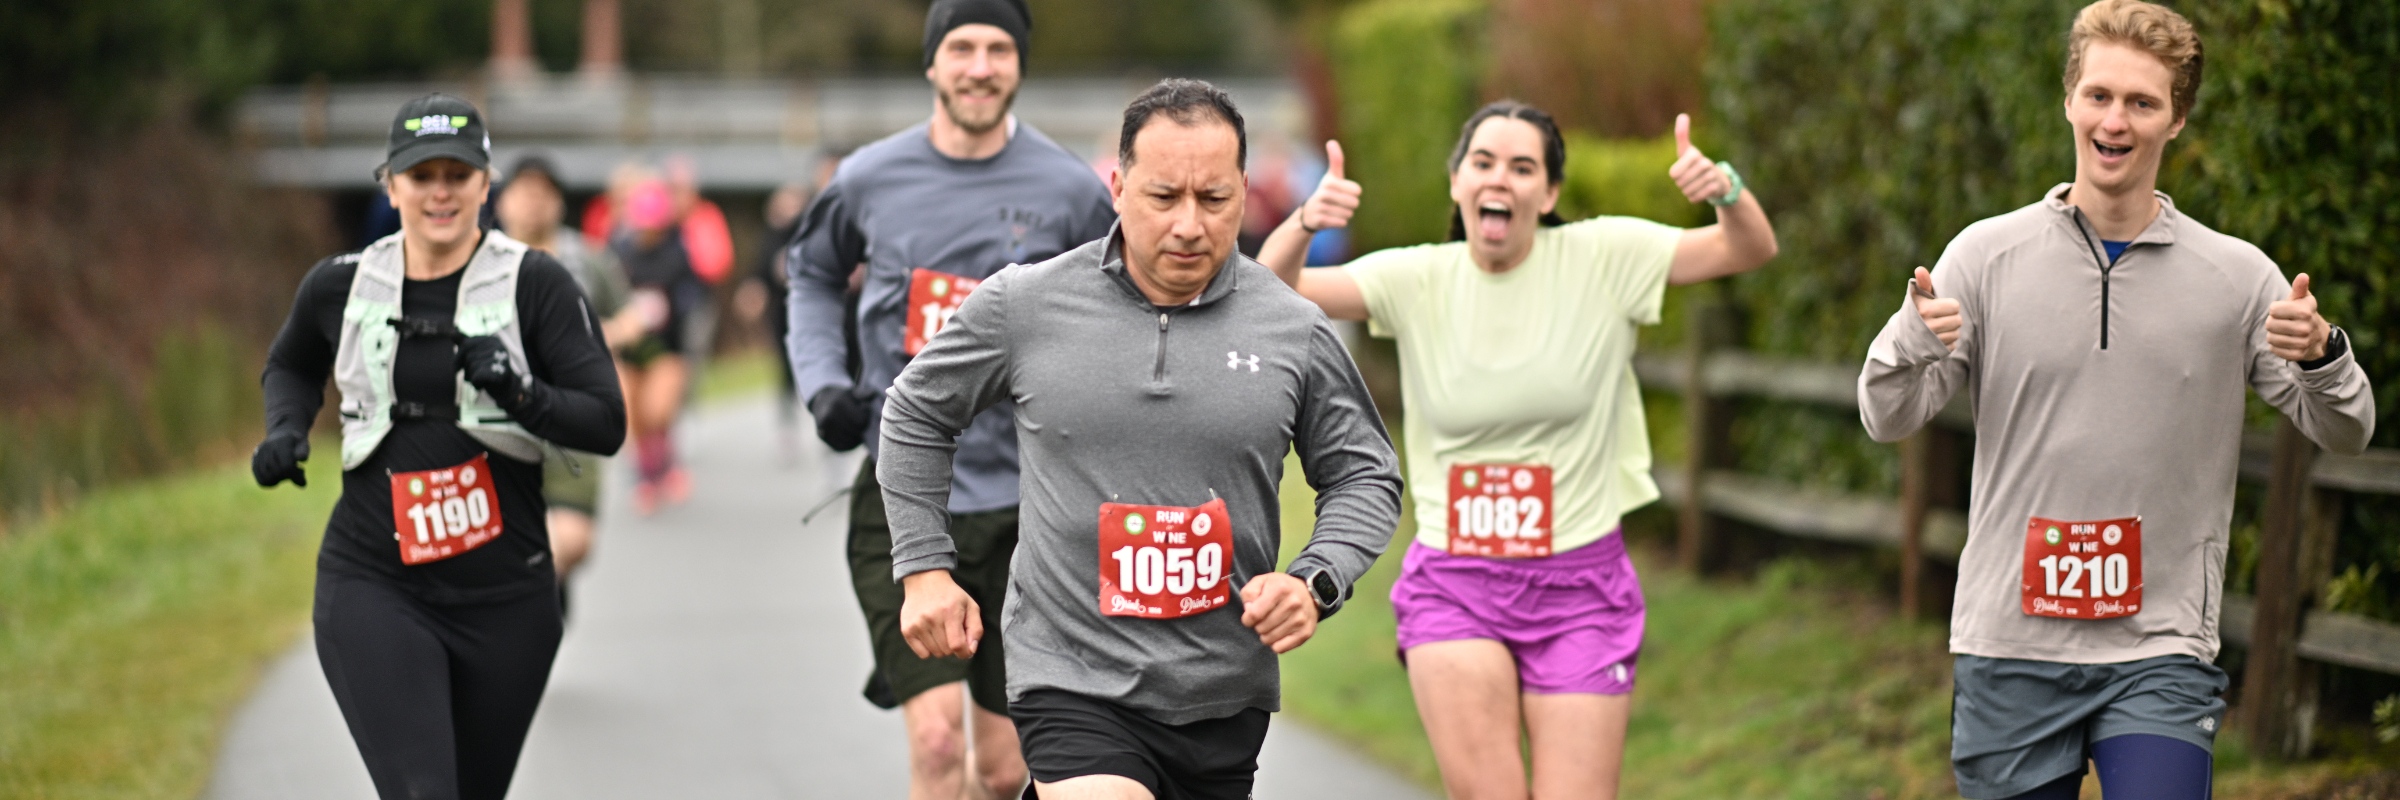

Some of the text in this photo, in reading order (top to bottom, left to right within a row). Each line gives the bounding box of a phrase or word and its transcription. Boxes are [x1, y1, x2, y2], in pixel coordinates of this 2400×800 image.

[407, 487, 490, 544] 1190
[1156, 511, 1184, 524] RUN
[1454, 495, 1544, 539] 1082
[2071, 525, 2096, 535] RUN
[1111, 543, 1222, 595] 1059
[2039, 553, 2128, 598] 1210
[1112, 595, 1146, 613] Drink
[1180, 595, 1211, 614] Drink
[2033, 597, 2064, 614] Drink
[2094, 600, 2125, 617] Drink
